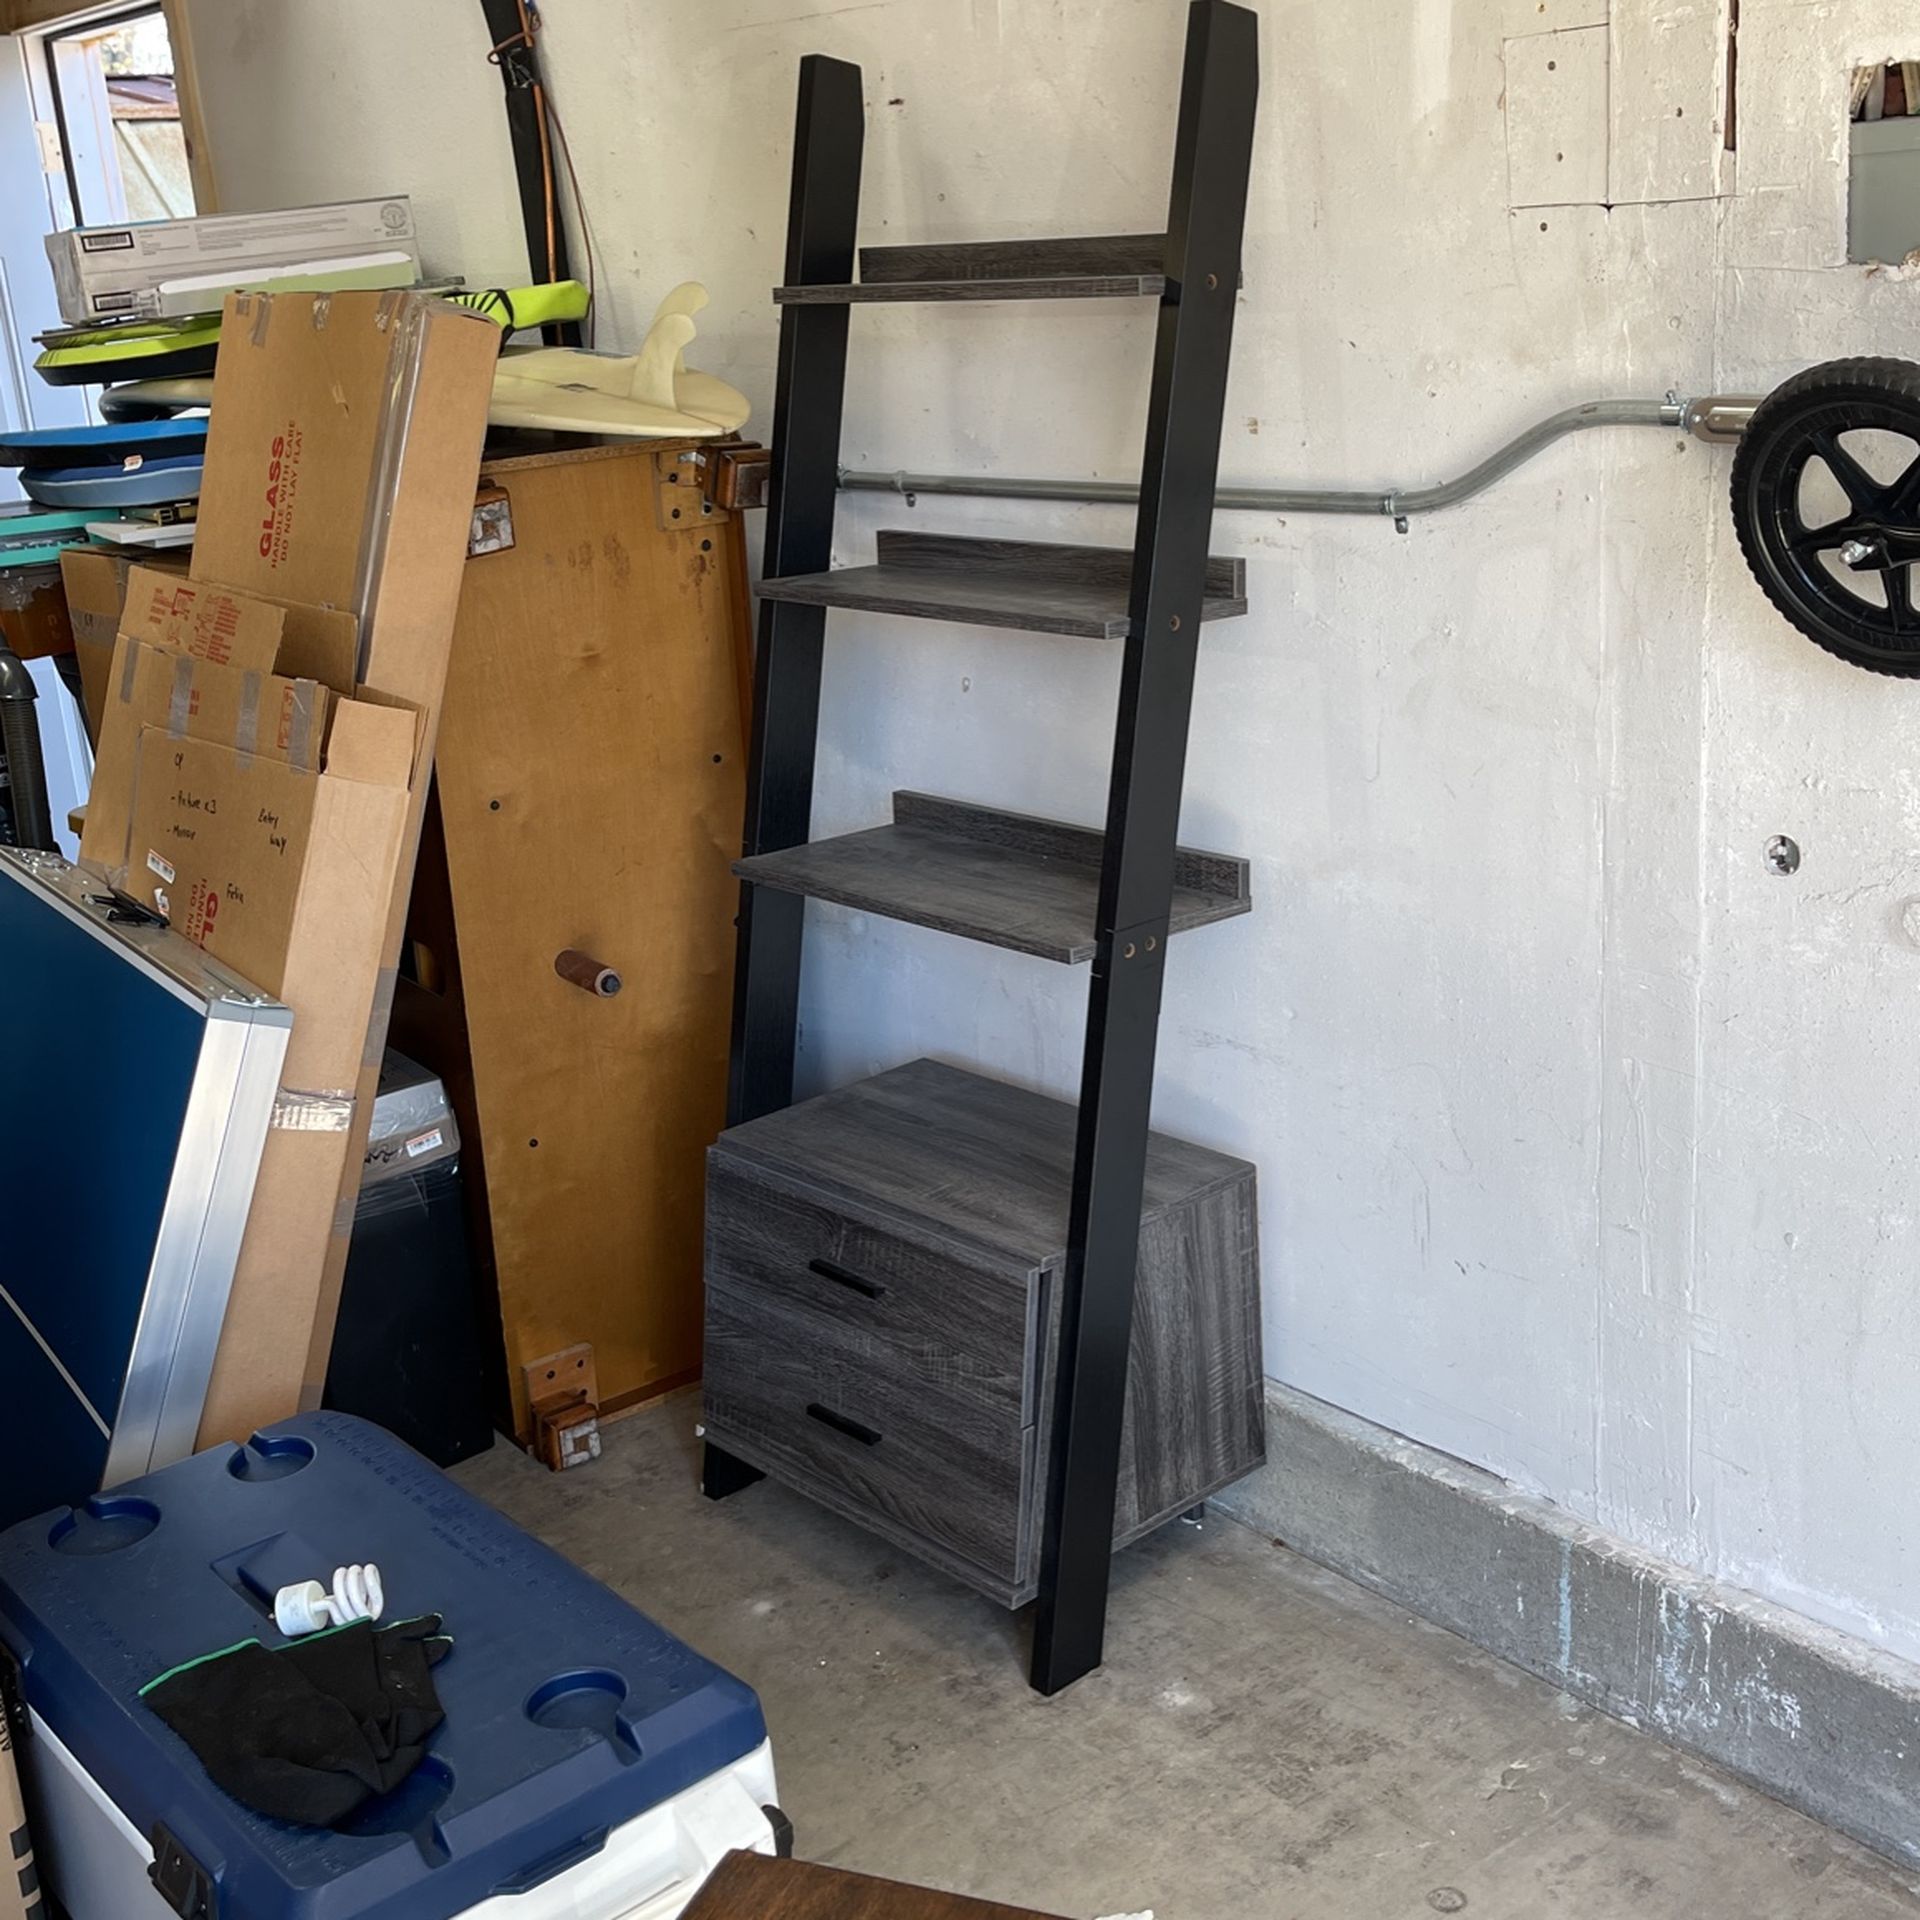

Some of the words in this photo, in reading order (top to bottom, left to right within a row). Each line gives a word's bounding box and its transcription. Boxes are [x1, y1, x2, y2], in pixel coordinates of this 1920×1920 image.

[293, 430, 303, 464] FLAT
[259, 436, 284, 557] GLASS
[271, 508, 285, 568] HANDLE
[279, 464, 290, 503] WITH
[286, 420, 296, 459] CARE
[289, 470, 298, 497] LAY
[284, 504, 294, 534] NOT
[280, 539, 289, 561] DO
[190, 884, 198, 907] DO
[200, 892, 218, 951] GL
